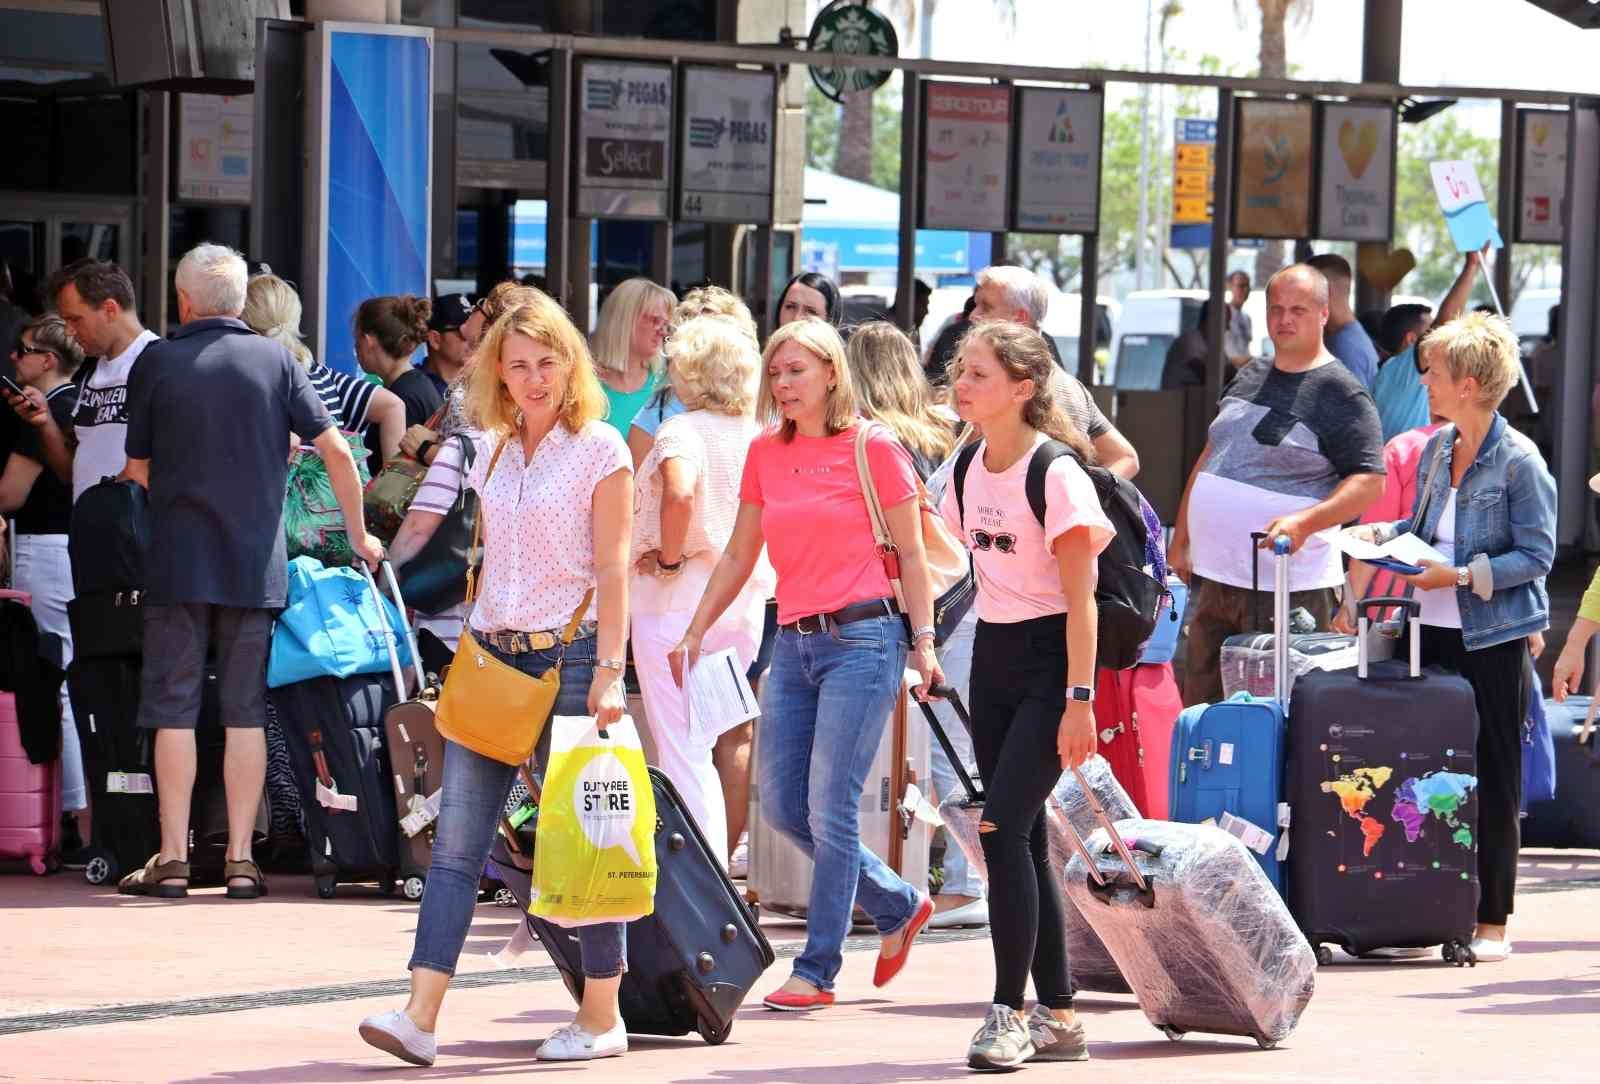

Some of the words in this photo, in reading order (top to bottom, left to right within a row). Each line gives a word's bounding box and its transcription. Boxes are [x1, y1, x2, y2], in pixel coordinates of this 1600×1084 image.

[628, 80, 666, 105] PEGAS
[729, 119, 767, 145] PEGAS
[600, 141, 652, 174] Select
[684, 195, 703, 213] 44
[610, 780, 628, 791] REE
[583, 793, 630, 812] STRE
